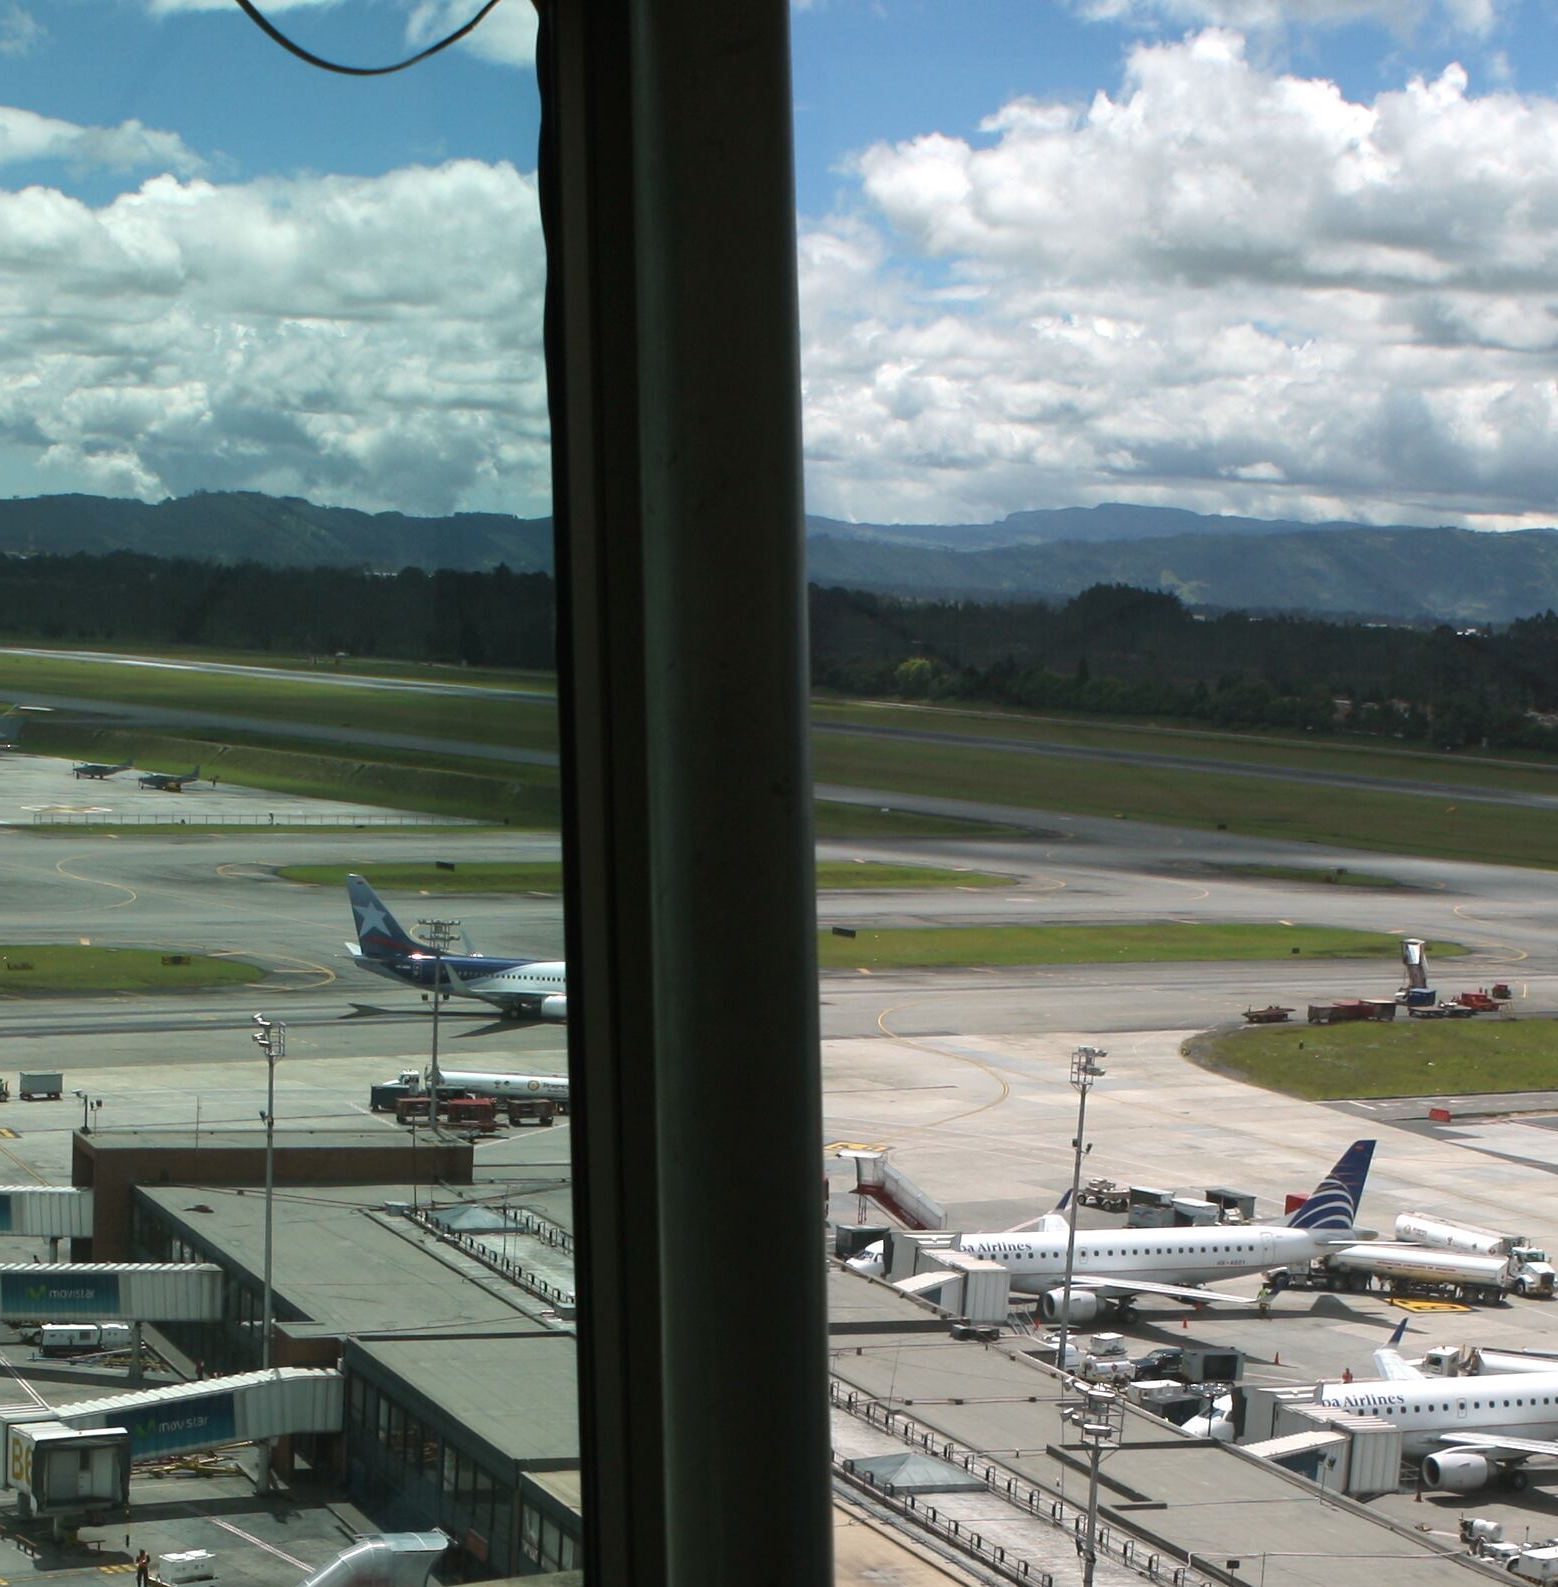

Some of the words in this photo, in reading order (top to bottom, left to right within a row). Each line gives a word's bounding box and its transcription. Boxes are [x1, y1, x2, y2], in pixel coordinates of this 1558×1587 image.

[977, 1241, 1032, 1253] Airlines
[48, 1288, 96, 1299] movistar
[1343, 1394, 1405, 1408] Airlines
[158, 1415, 210, 1433] movstar
